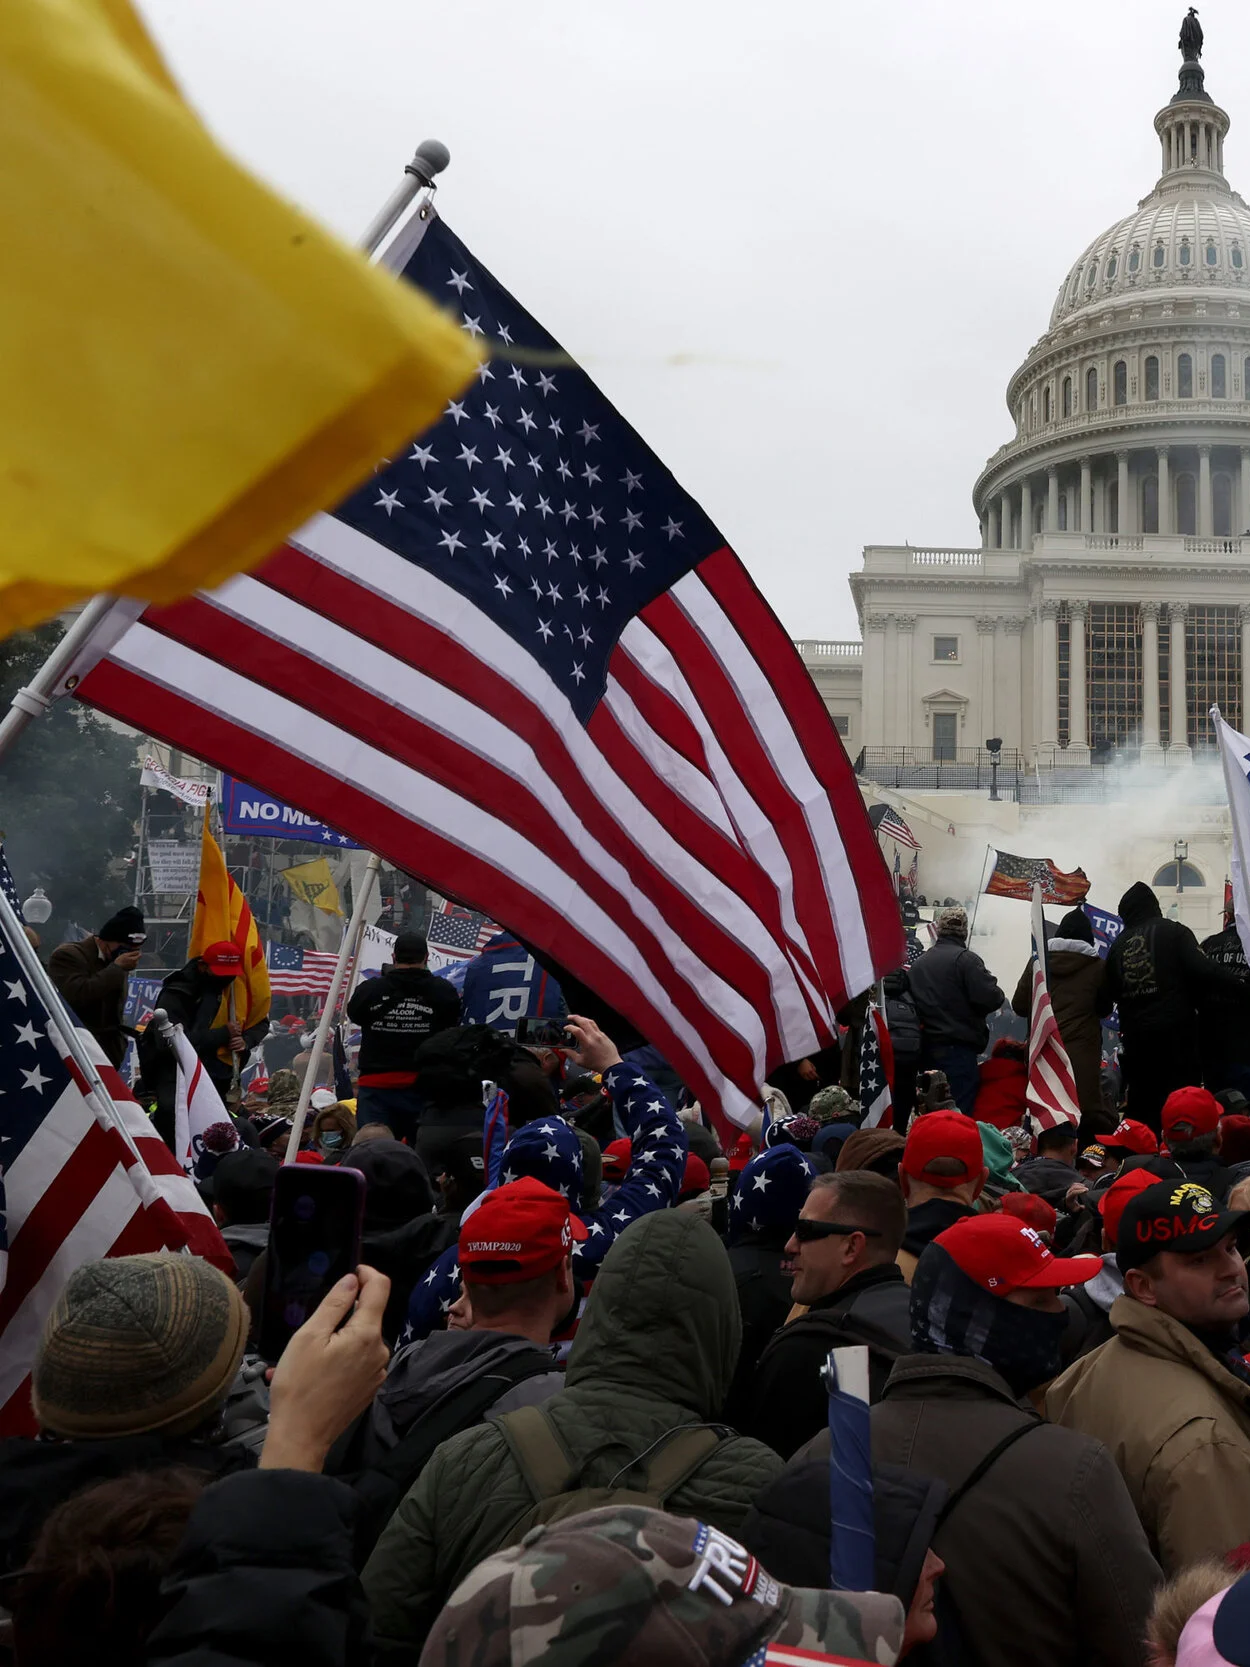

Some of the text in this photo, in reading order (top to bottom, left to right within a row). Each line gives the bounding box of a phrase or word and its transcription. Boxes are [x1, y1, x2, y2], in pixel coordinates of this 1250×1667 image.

[239, 801, 281, 821] NO
[1223, 953, 1234, 964] OF
[1136, 1213, 1220, 1244] USMC
[467, 1241, 522, 1252] TRUMP2020
